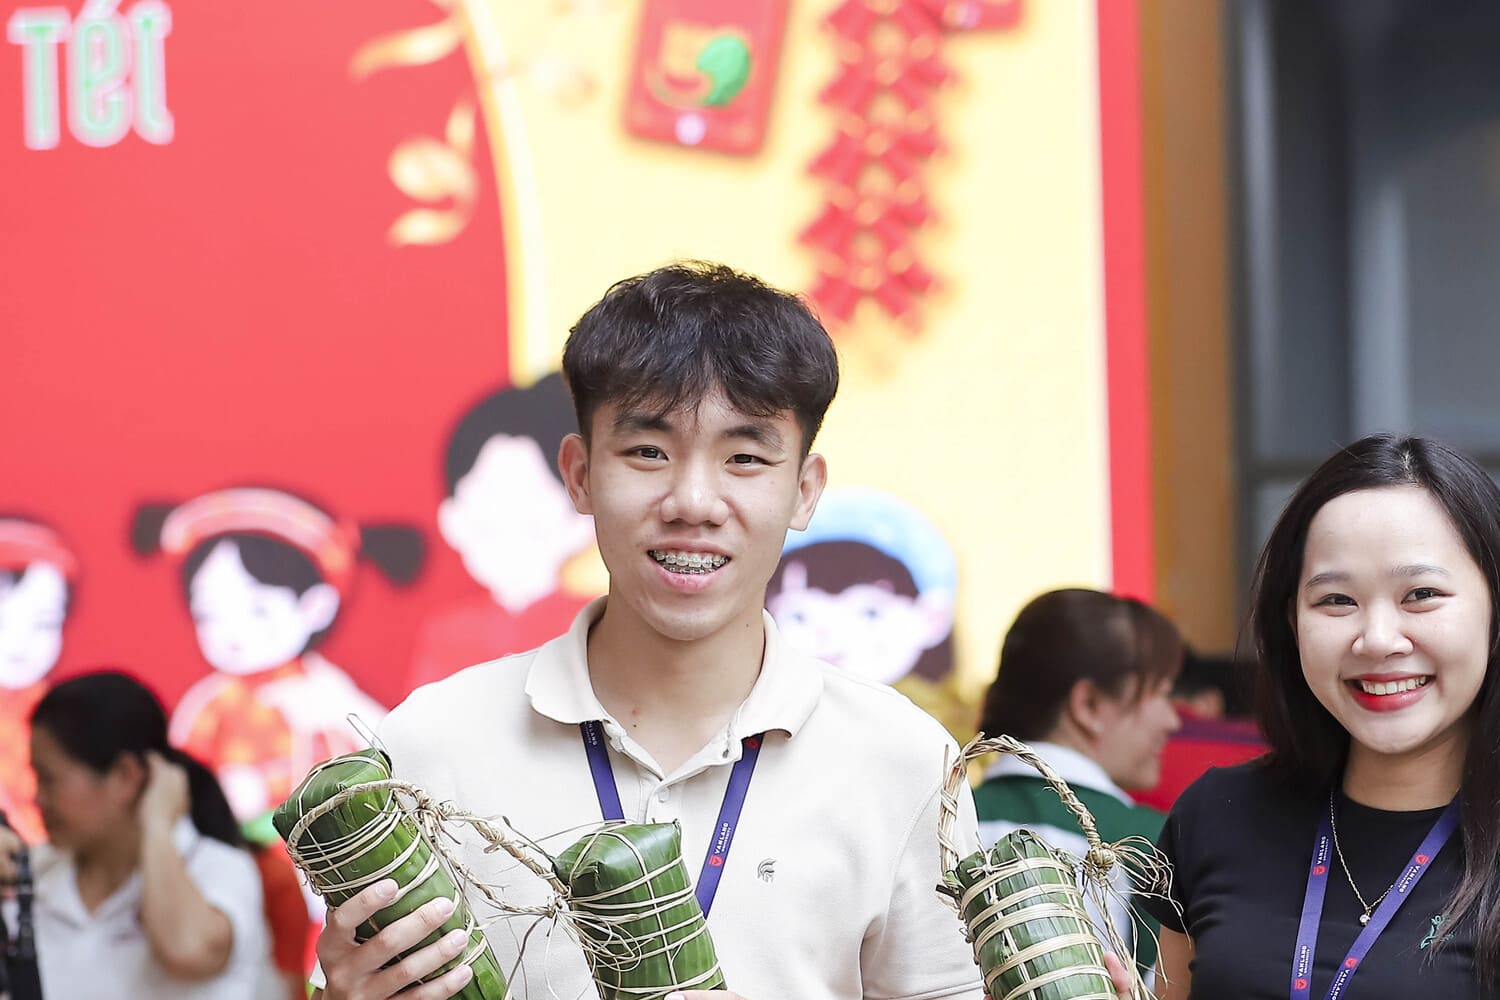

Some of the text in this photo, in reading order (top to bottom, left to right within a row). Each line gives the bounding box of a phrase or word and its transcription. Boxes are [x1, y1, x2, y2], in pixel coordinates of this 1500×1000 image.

[714, 822, 729, 855] VANLANG
[1316, 836, 1327, 865] VANLANG
[1399, 865, 1421, 893] VANLANG
[1297, 945, 1308, 978] VANLANG
[1331, 969, 1350, 1000] VANLANG
